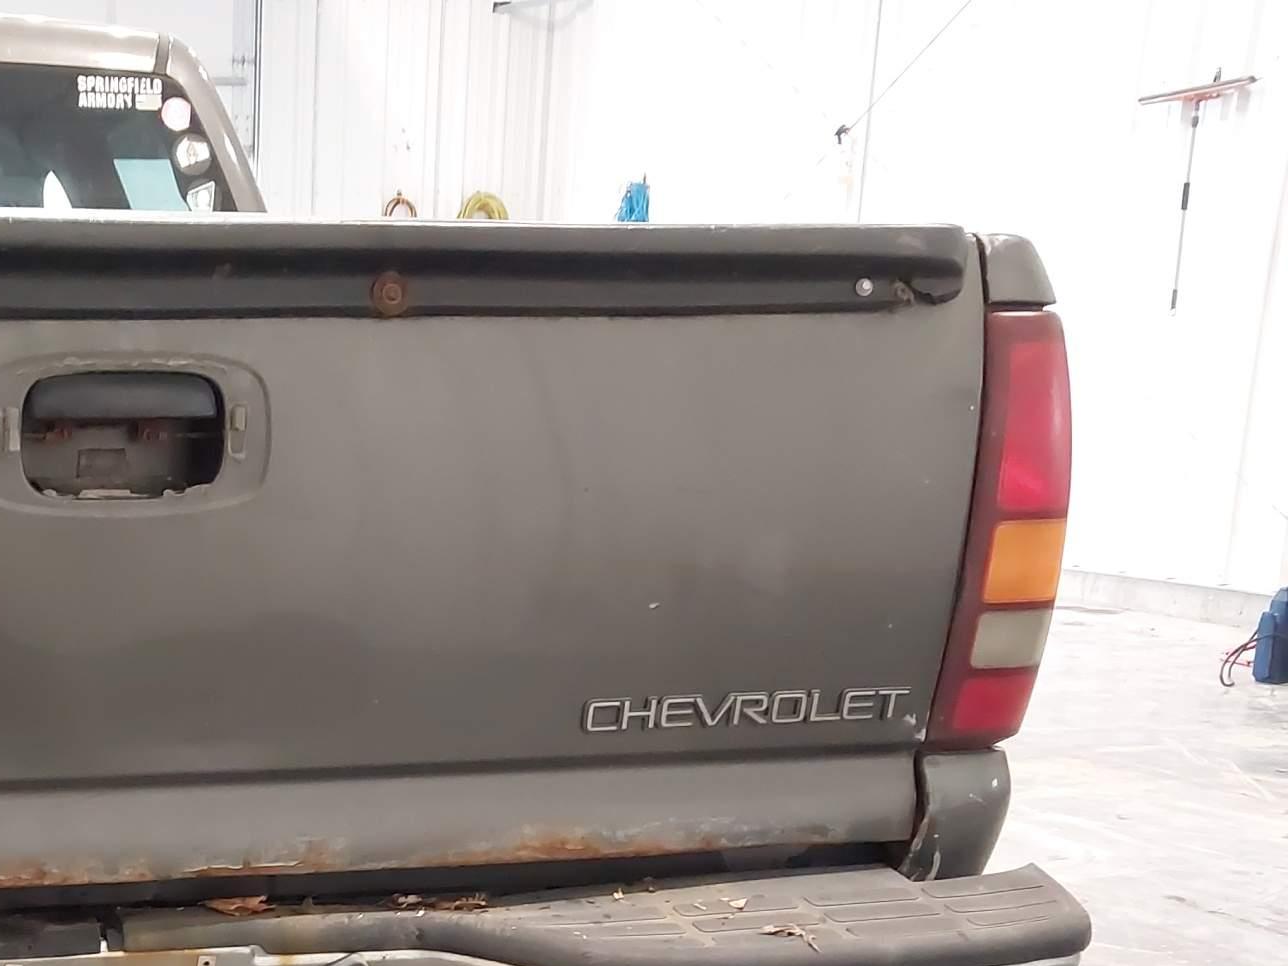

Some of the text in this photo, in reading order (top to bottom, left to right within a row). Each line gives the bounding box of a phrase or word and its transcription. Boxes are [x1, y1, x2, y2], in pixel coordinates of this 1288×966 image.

[77, 74, 162, 94] SPRINGFIELD
[78, 92, 132, 110] ARMORY
[582, 686, 912, 733] CHEVROLET
